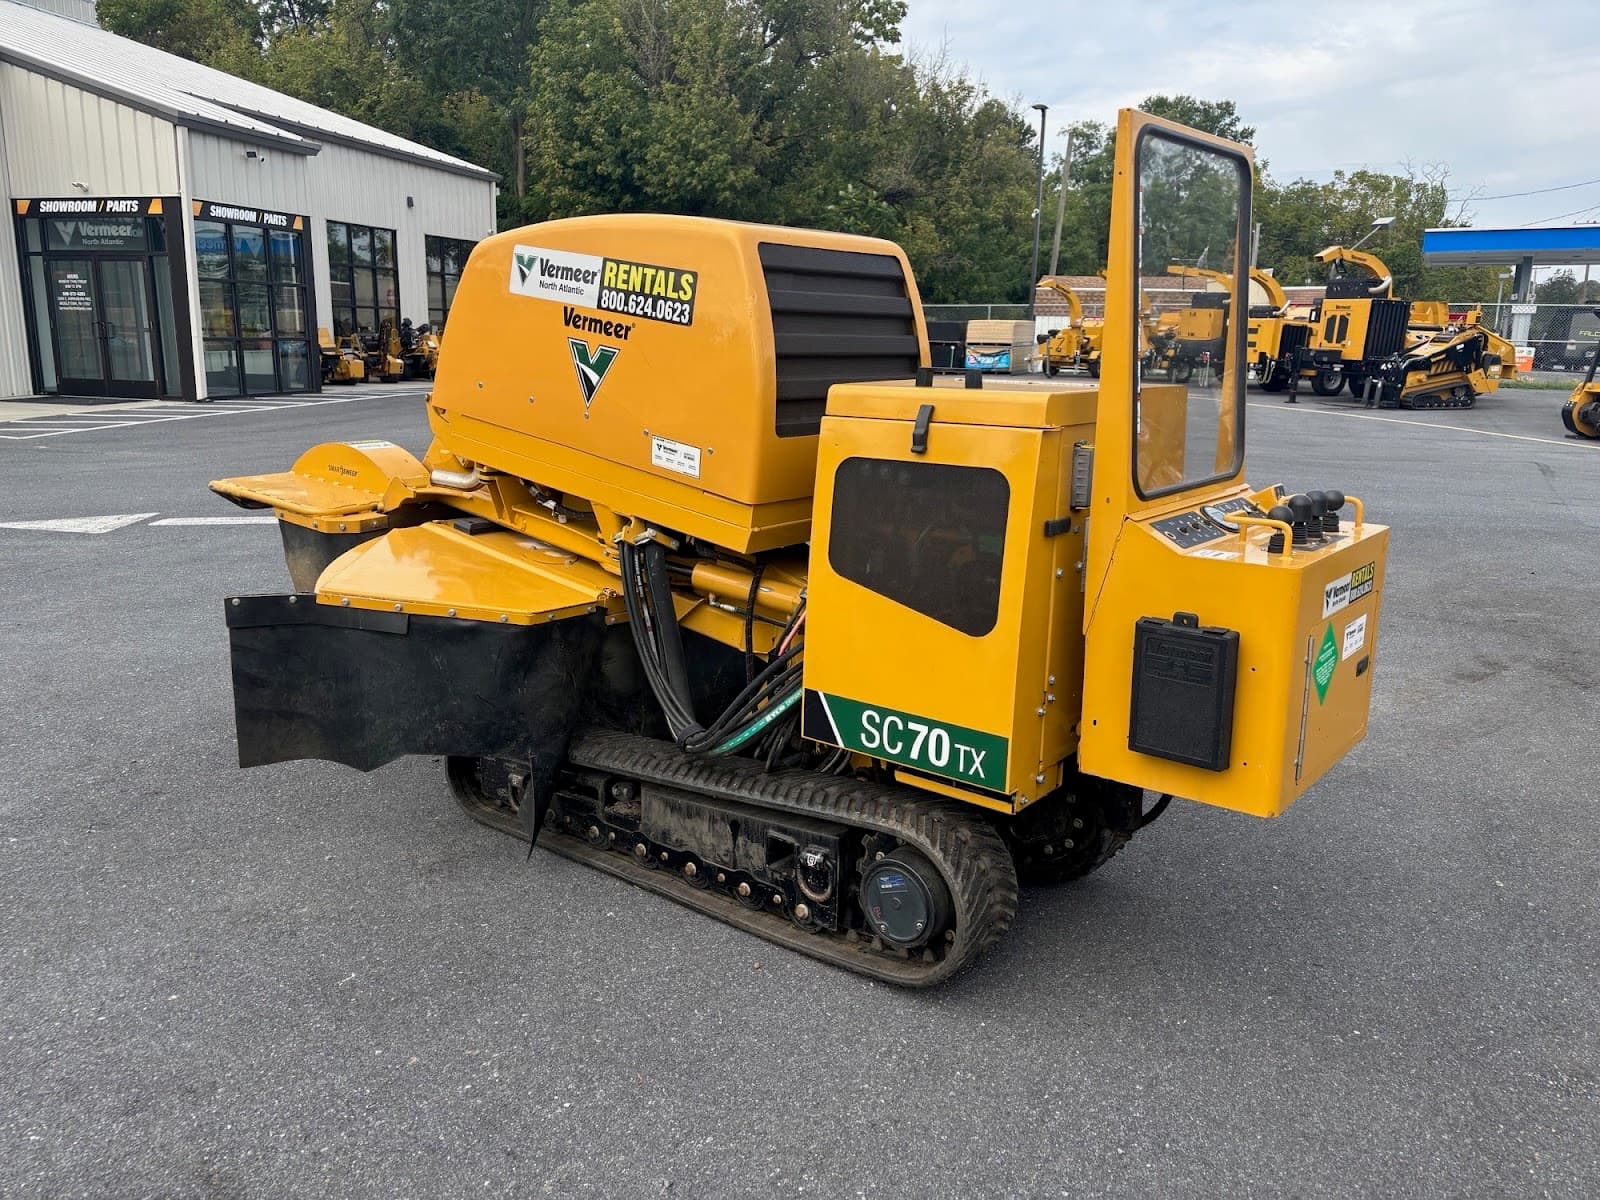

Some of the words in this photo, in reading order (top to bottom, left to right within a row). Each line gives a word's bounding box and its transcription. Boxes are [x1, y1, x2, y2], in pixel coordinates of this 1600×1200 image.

[39, 200, 97, 213] SHOWROOM
[106, 200, 139, 212] PARTS
[209, 205, 257, 222] SHOWROOM
[264, 213, 287, 227] PARTS
[78, 221, 132, 236] Vermeer
[539, 258, 598, 286] Vermeer
[603, 261, 694, 301] RENTALS
[539, 280, 558, 292] North
[558, 283, 585, 296] Atlantic
[600, 289, 690, 324] 800.624.0623
[563, 306, 632, 340] Vermeer
[1352, 562, 1375, 587] RENTALS
